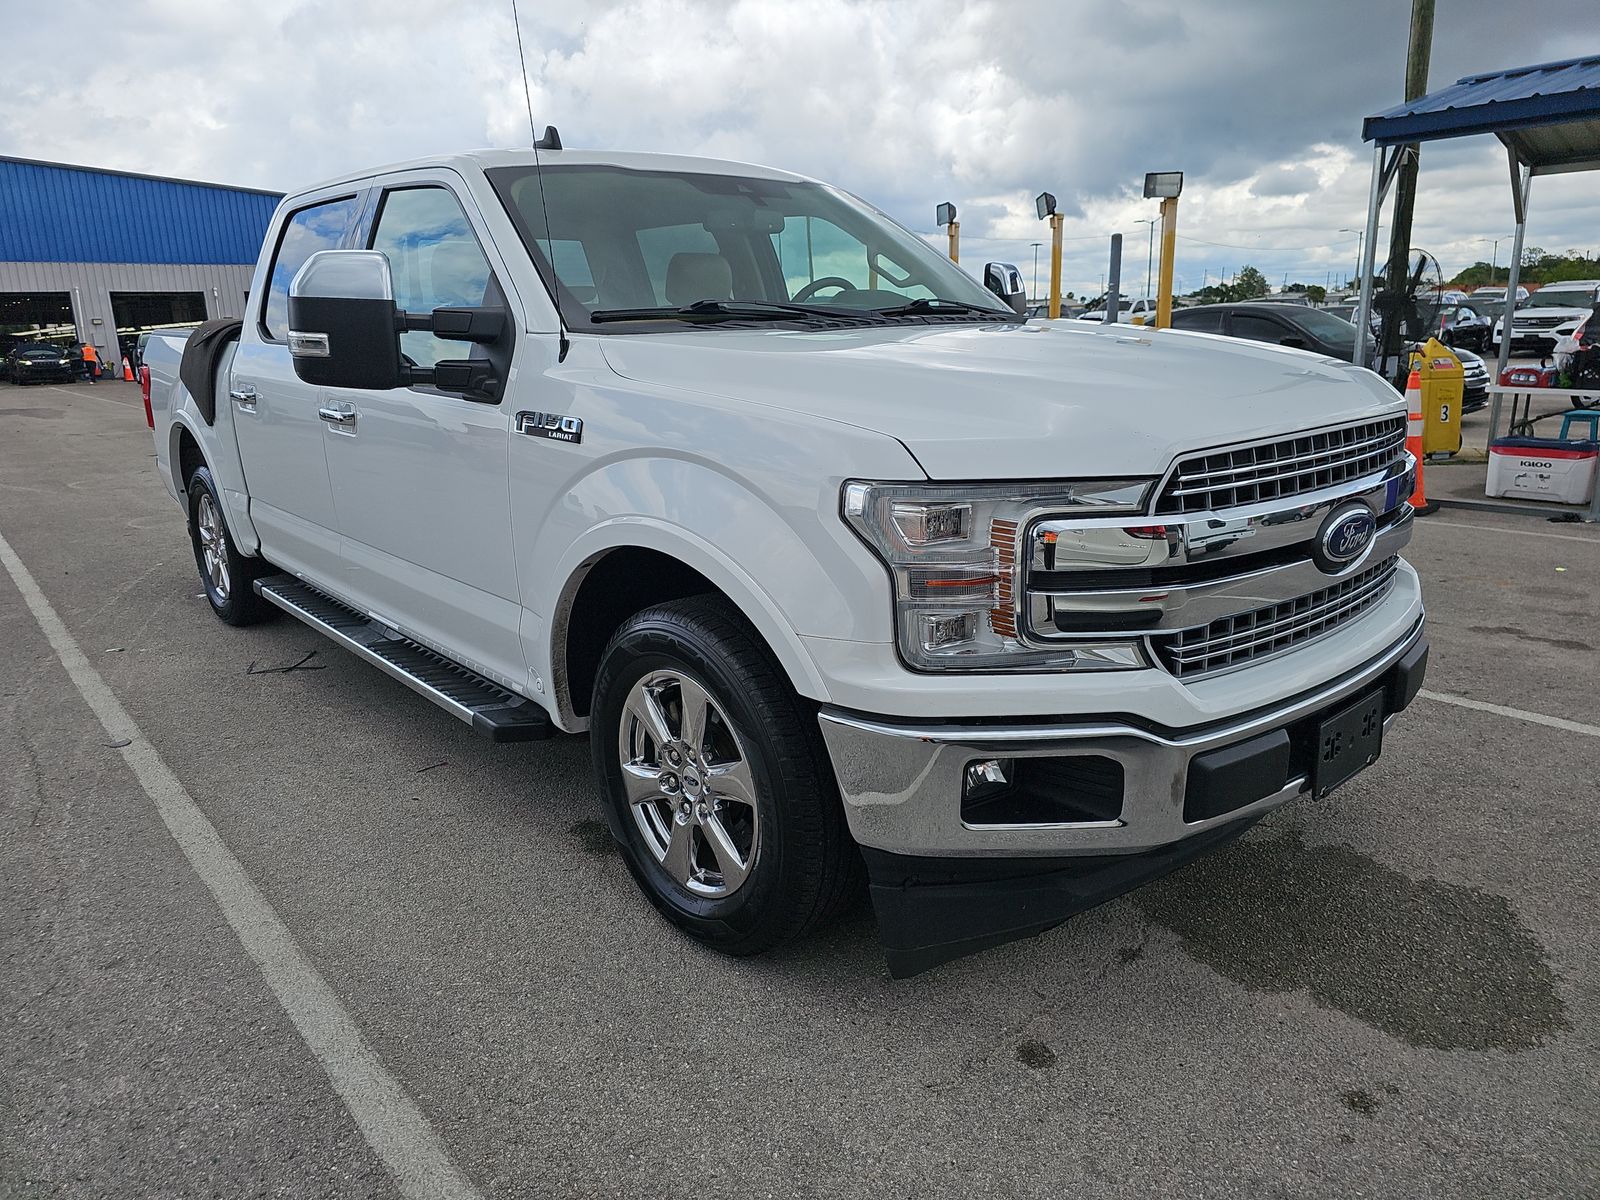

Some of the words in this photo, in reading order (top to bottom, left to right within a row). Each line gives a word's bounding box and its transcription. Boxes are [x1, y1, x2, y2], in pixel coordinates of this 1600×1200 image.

[1440, 405, 1449, 421] 3
[548, 431, 573, 441] LARIAT
[1520, 460, 1553, 469] IGLOO
[1340, 520, 1369, 552] Ford
